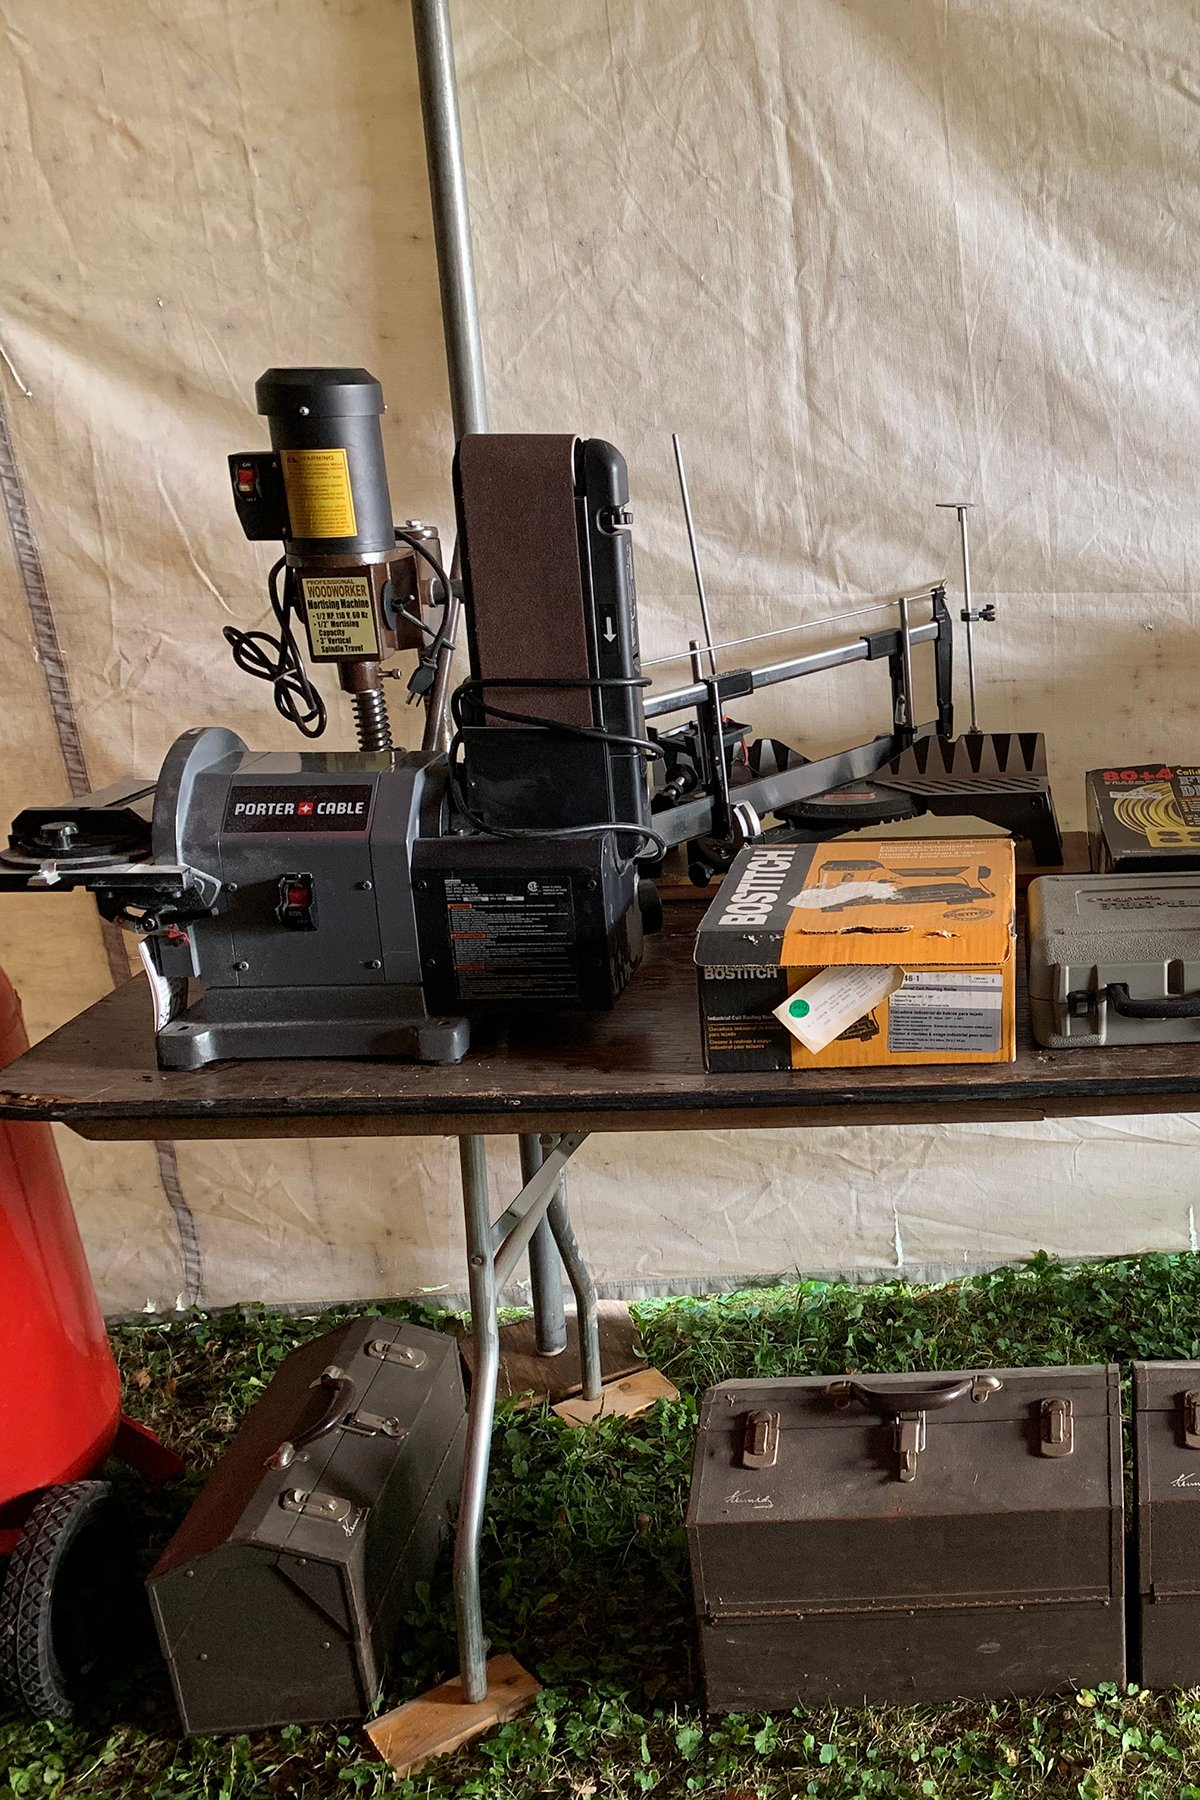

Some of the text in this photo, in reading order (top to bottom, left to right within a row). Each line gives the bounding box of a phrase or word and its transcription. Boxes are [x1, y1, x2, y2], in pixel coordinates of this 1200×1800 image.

[308, 585, 367, 598] WOODWORKER
[308, 599, 369, 610] Mortising Machine
[1103, 768, 1174, 781] 80+4
[234, 802, 364, 815] PORTER CABLE
[718, 851, 796, 925] BOSTITCH
[704, 966, 778, 980] BOSTITCH
